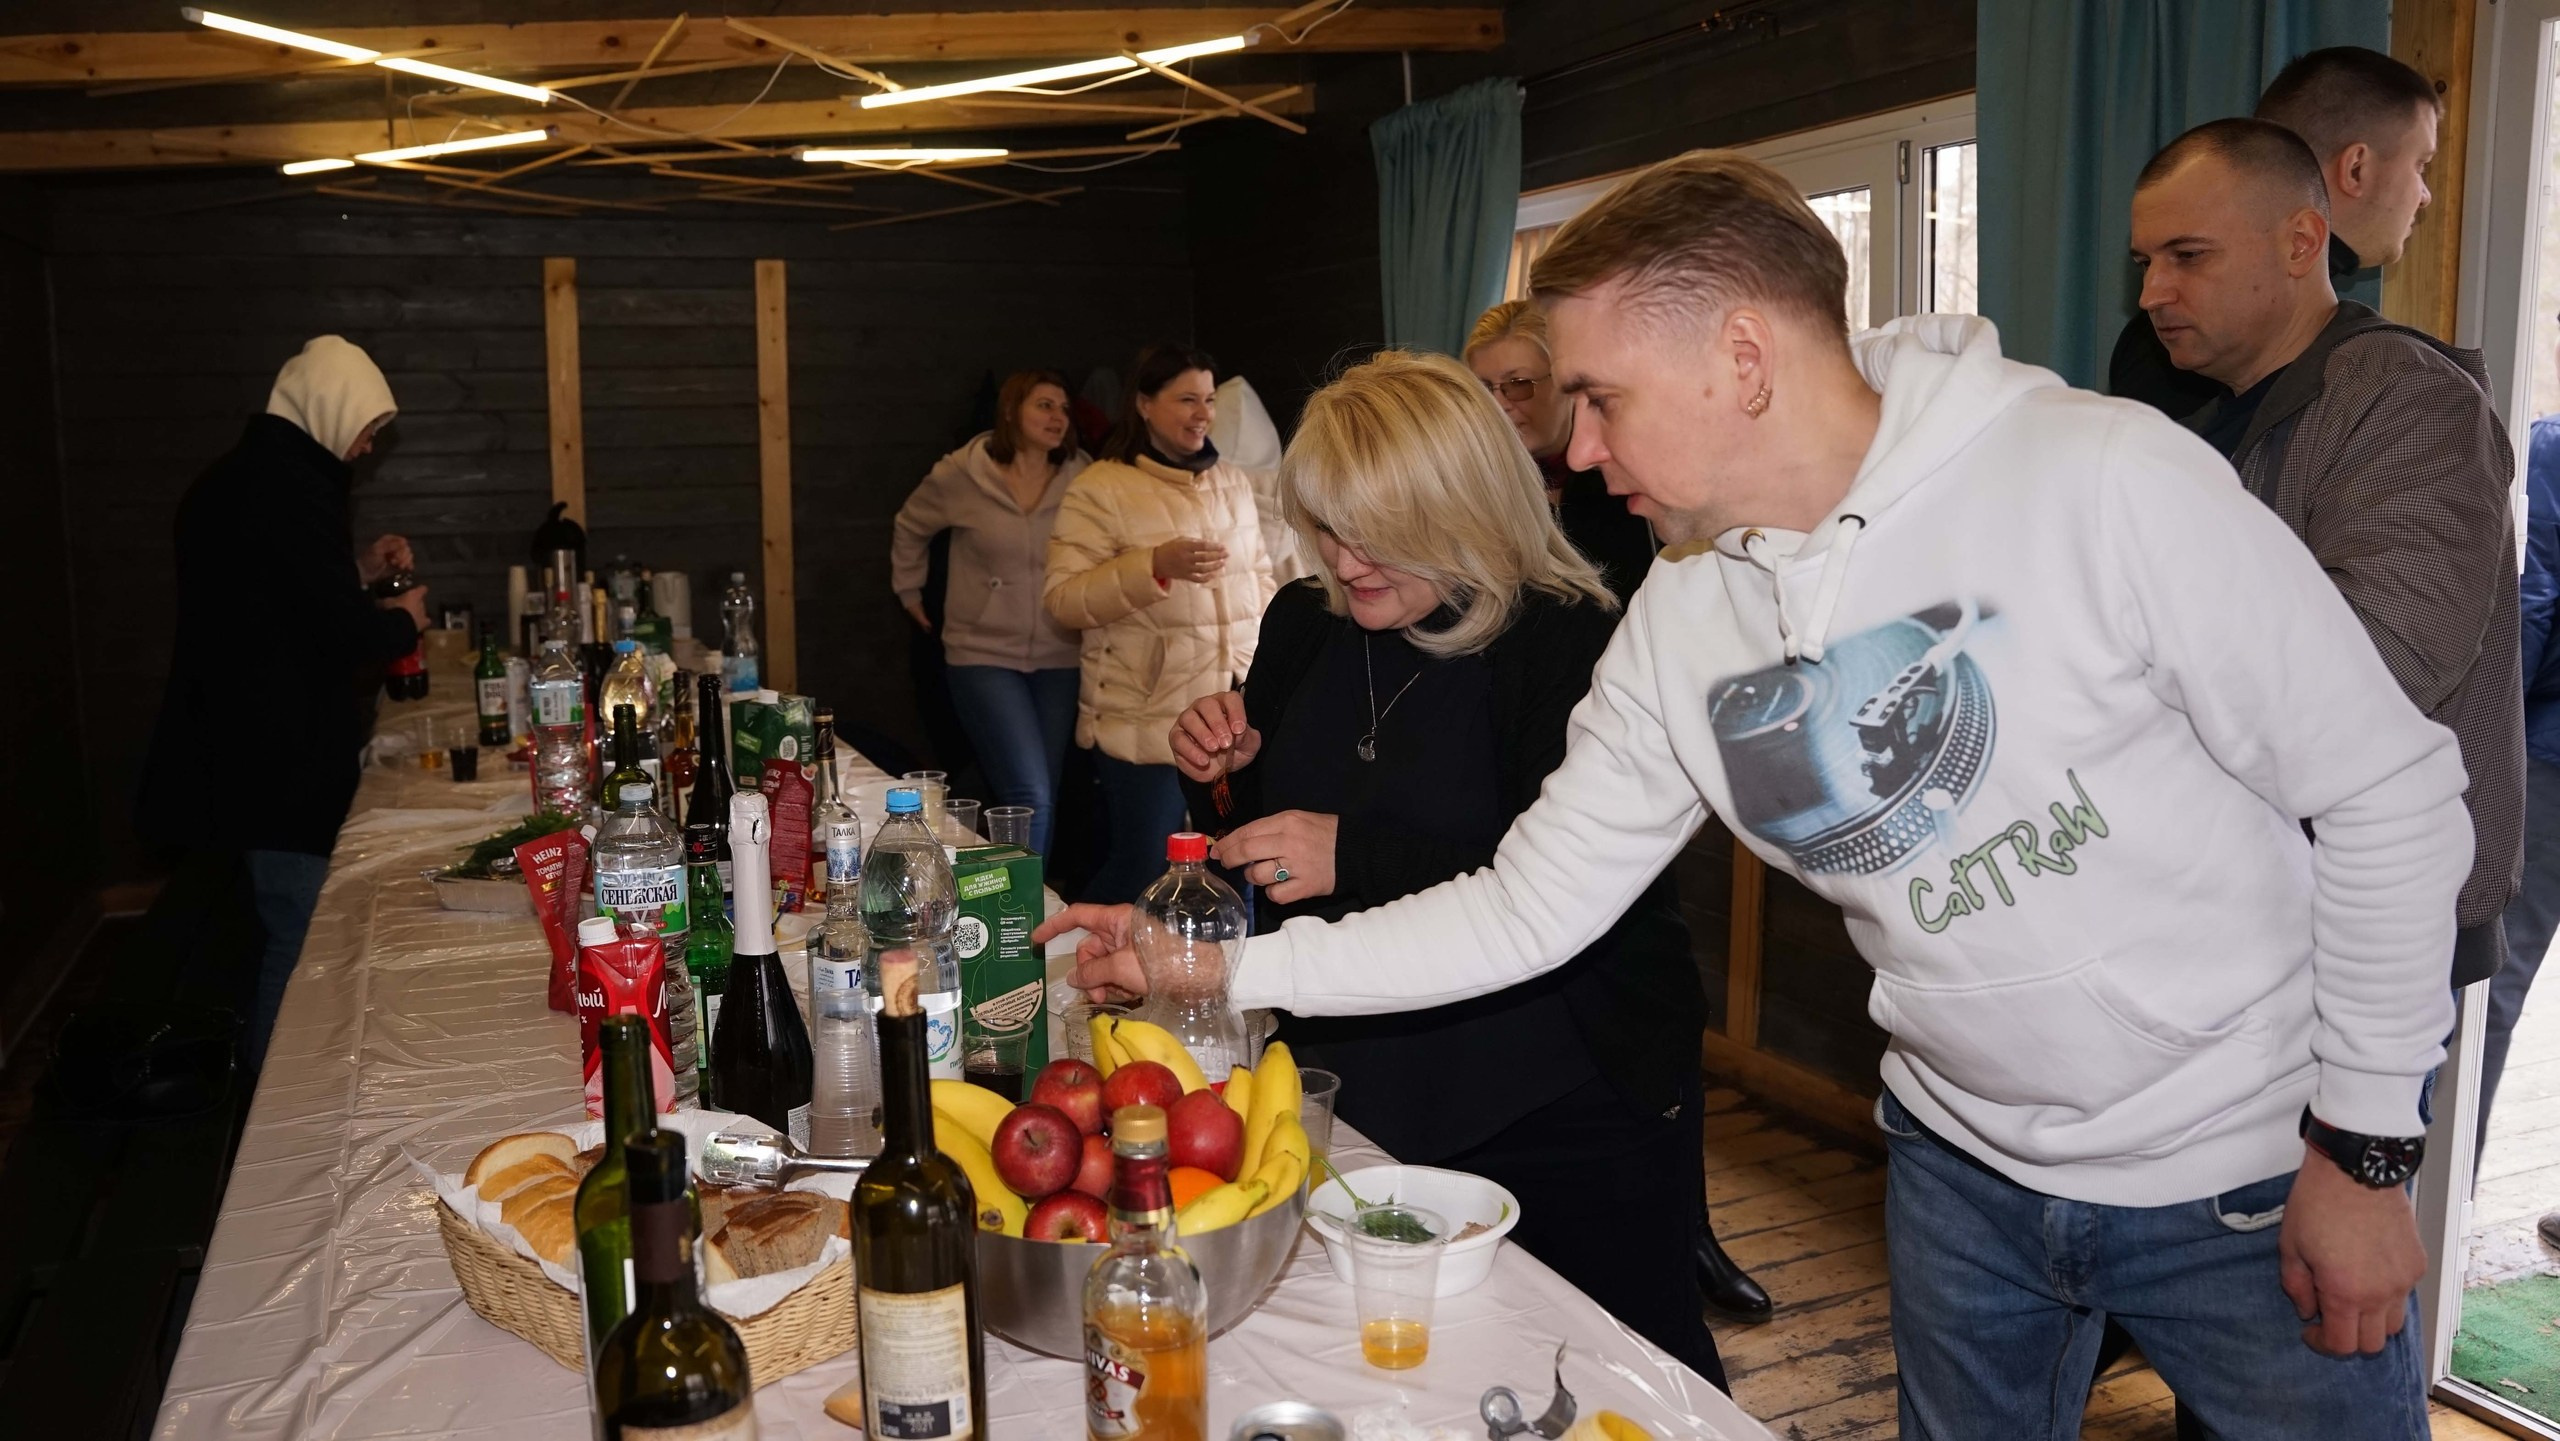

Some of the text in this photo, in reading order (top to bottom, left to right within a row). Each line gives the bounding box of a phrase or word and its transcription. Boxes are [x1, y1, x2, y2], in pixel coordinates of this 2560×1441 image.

[532, 847, 562, 864] HEINZ
[964, 876, 1007, 892] ДЛЯ УЖИНОВ
[974, 873, 994, 883] ИДЕИ
[601, 884, 678, 905] СЕНЕЖСКАЯ
[973, 883, 1004, 895] ПОЛЬЗОЙ
